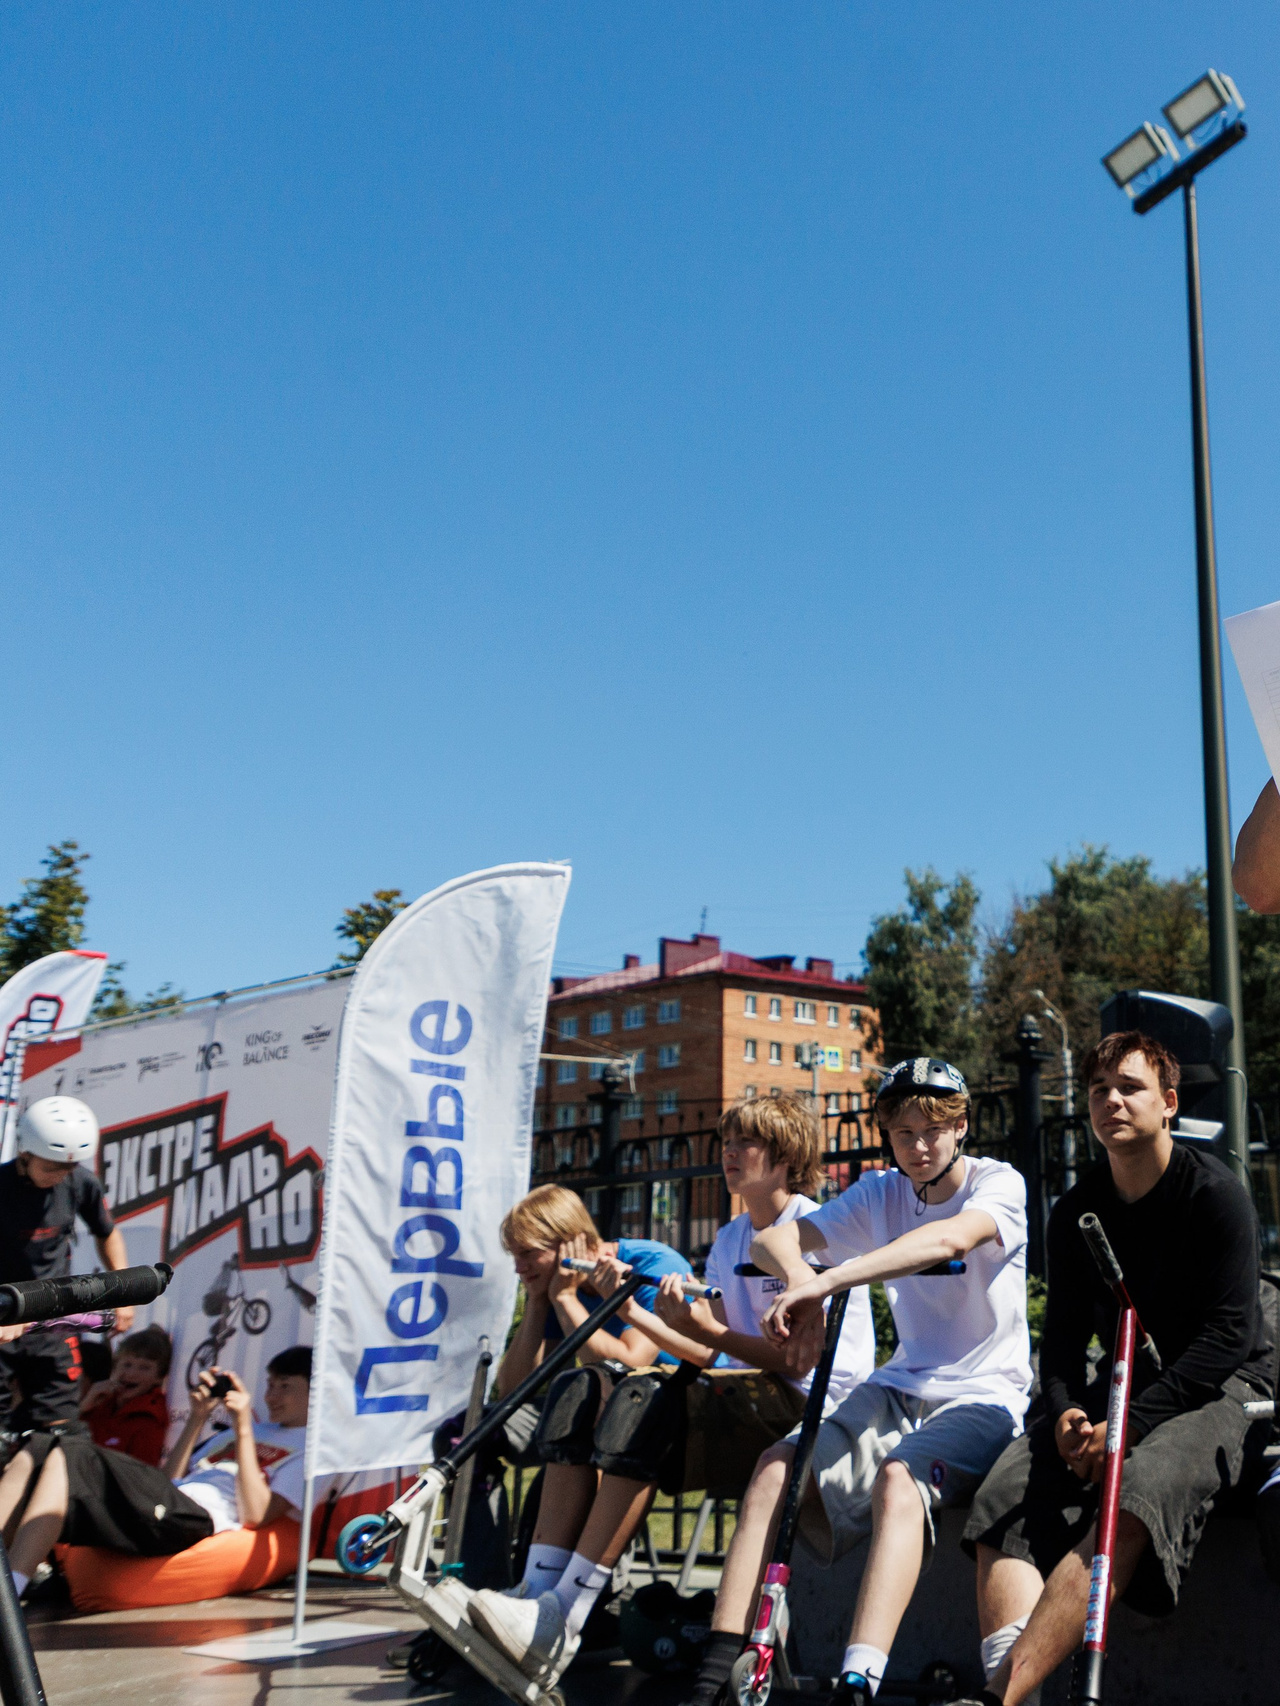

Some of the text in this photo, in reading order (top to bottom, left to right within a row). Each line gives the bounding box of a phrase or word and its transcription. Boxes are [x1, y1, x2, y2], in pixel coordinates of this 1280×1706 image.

[245, 1030, 271, 1047] KING
[103, 1114, 216, 1210] ЭКСТРЕ
[169, 1144, 281, 1251] МАЛЬ
[248, 1168, 314, 1251] НО
[355, 999, 485, 1415] Первые
